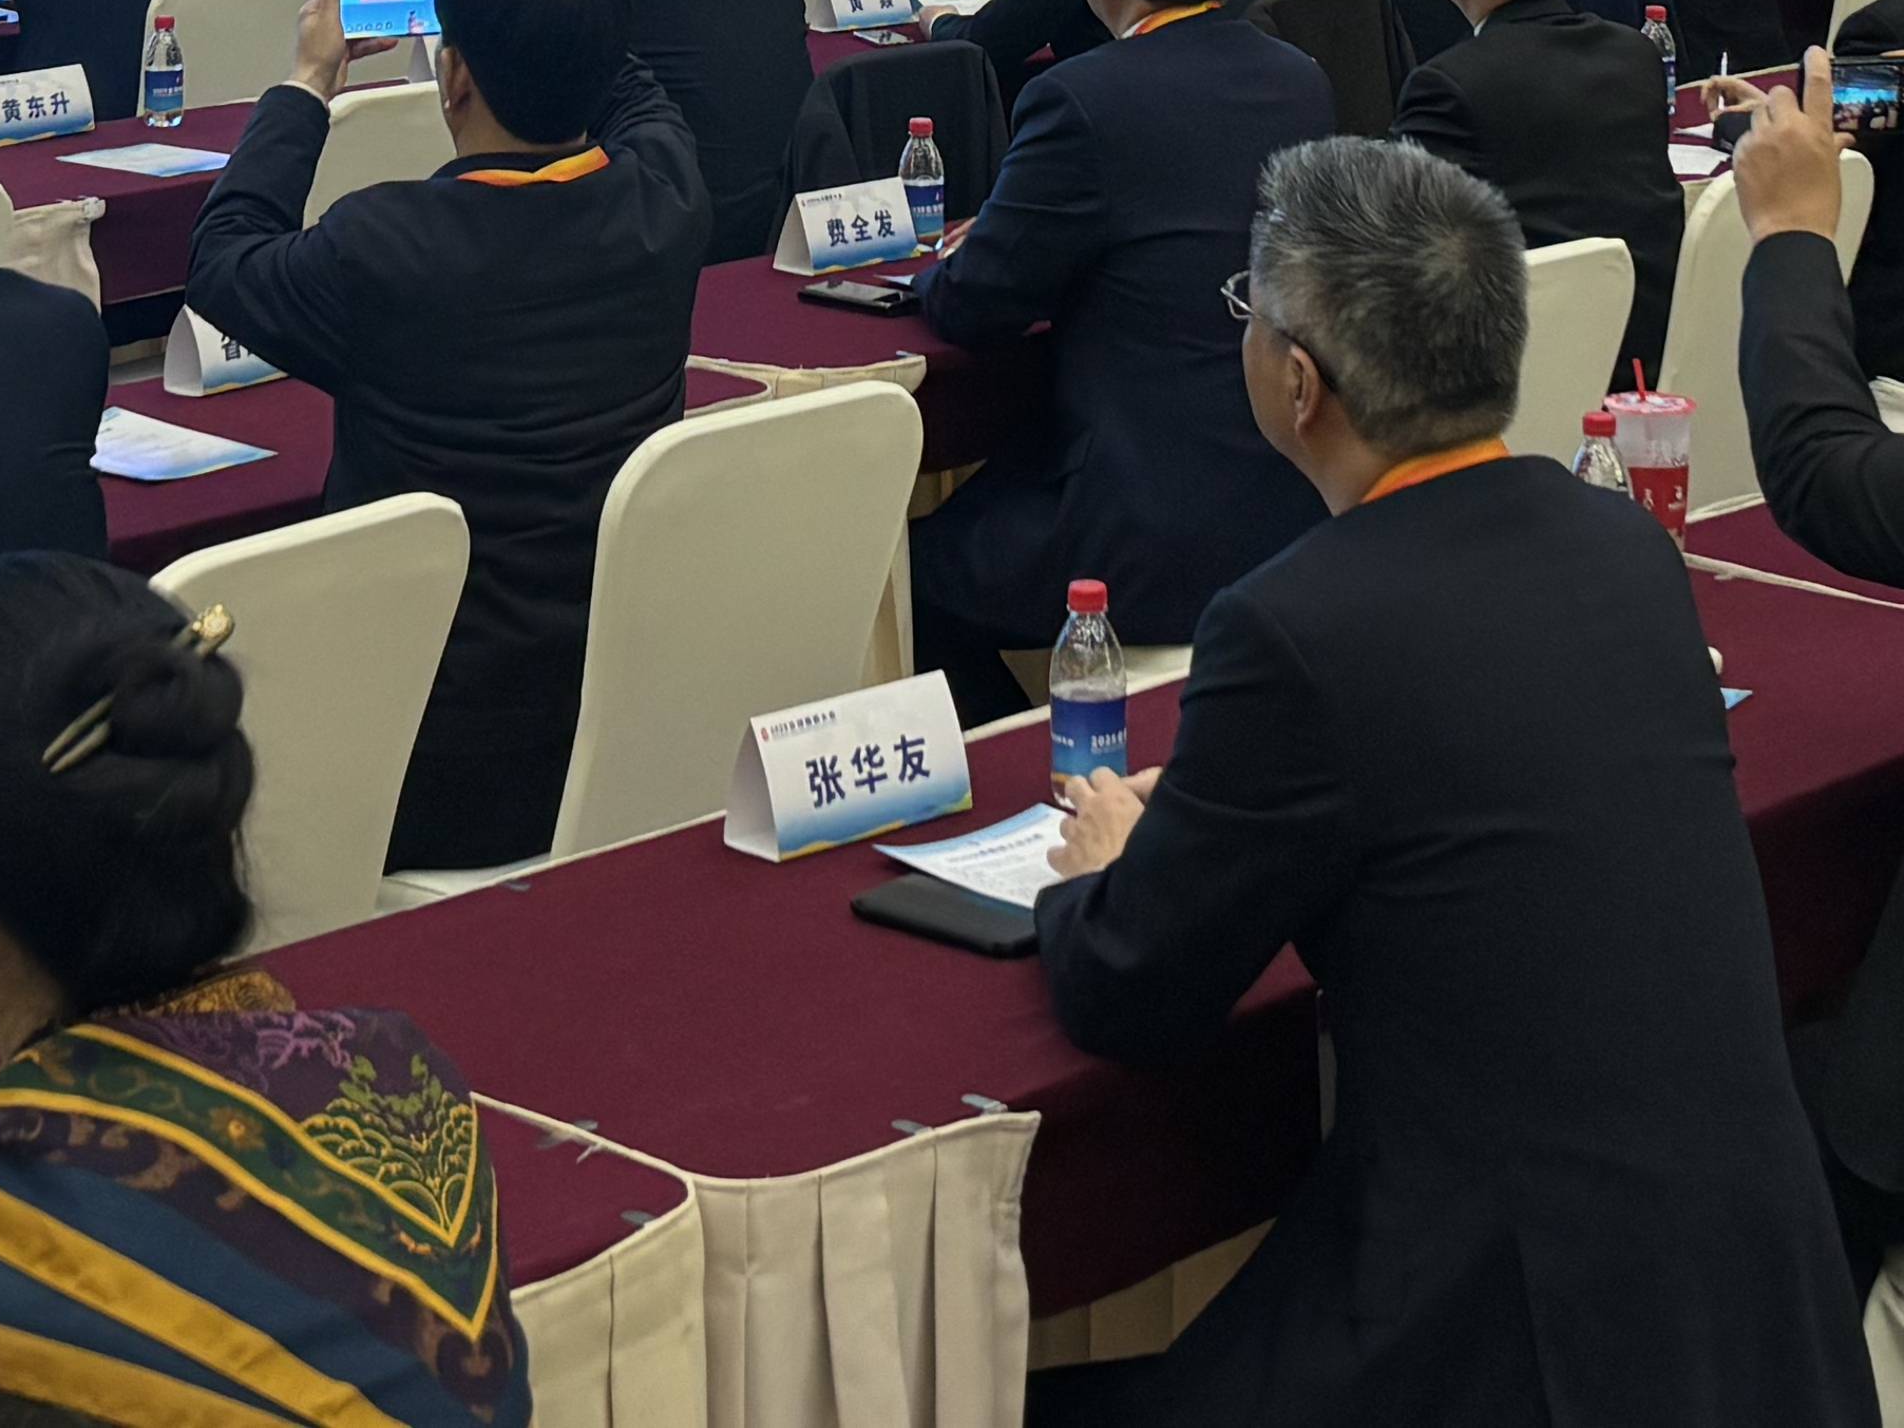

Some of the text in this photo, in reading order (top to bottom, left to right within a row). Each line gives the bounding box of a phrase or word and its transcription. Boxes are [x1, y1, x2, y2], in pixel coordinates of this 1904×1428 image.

[1, 91, 71, 123] 黄东升
[805, 734, 932, 809] 张华友
